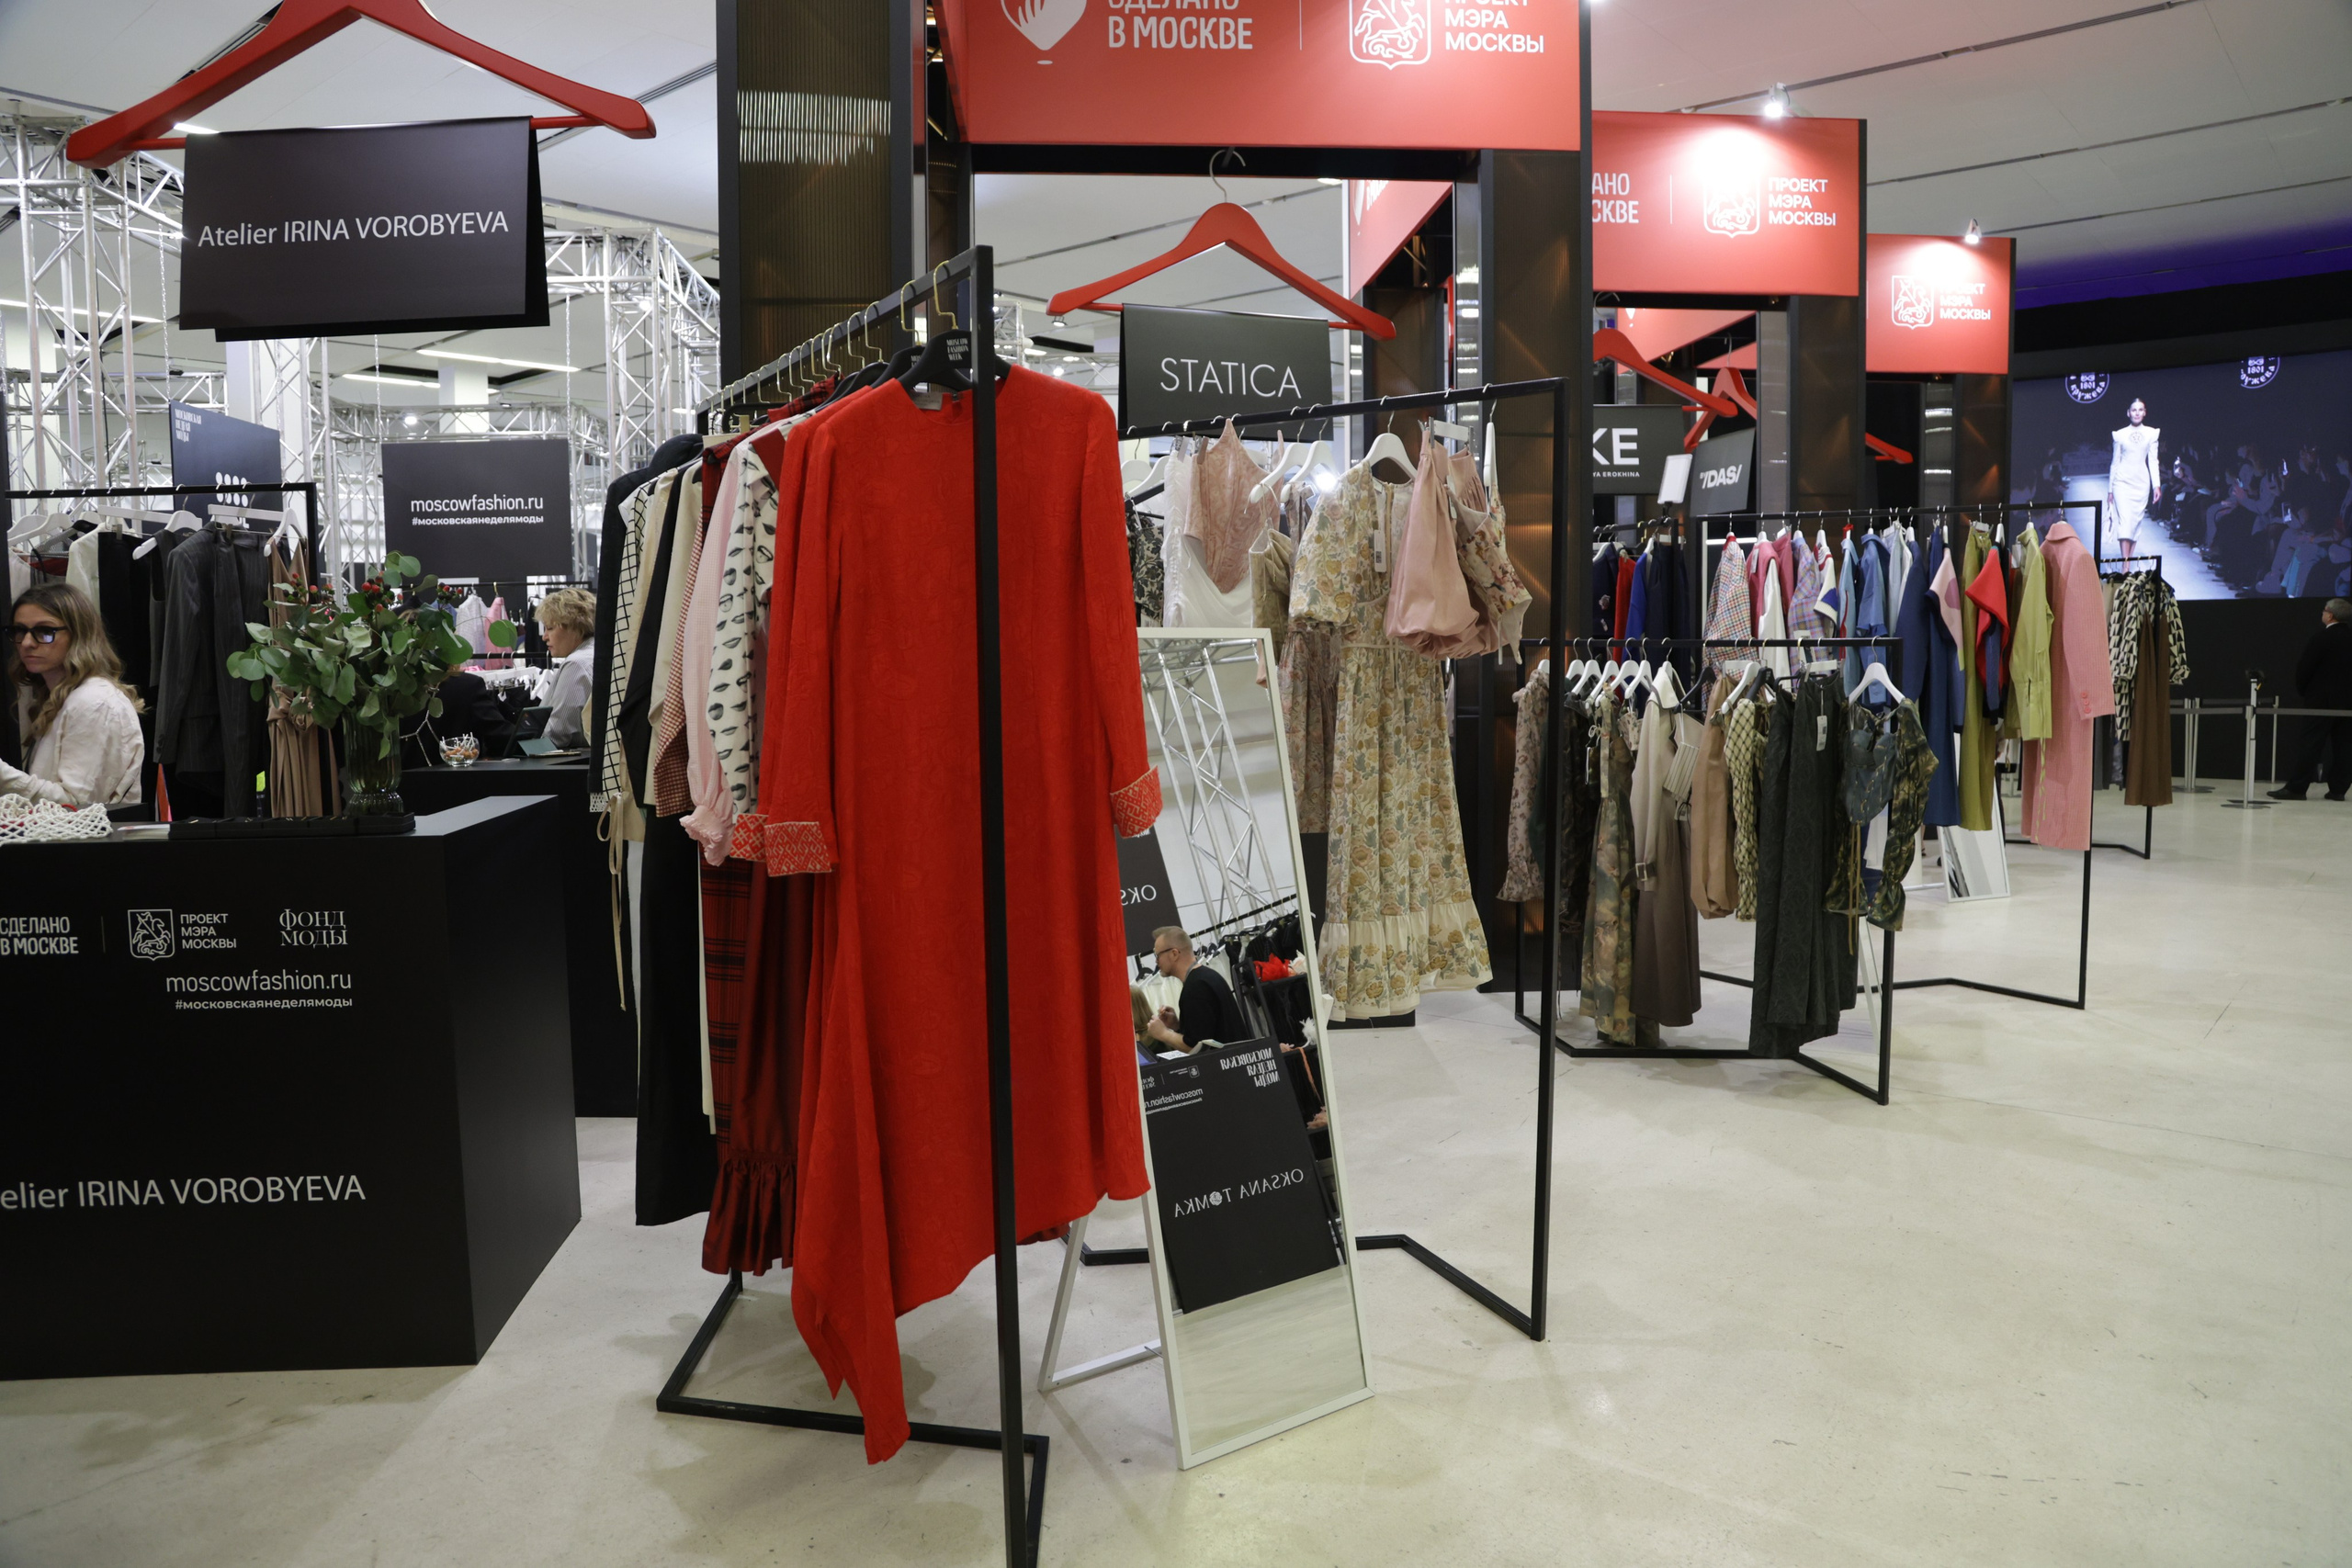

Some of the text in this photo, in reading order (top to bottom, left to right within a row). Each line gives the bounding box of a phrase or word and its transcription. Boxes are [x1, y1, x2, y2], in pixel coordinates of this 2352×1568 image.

[1445, 8, 1509, 28] МЭРА
[1108, 16, 1253, 50] В МОСКВЕ
[1445, 31, 1544, 53] МОСКВЫ
[1769, 177, 1828, 193] ПРОЕКТ
[1769, 194, 1813, 209] МЭРА
[1592, 199, 1640, 223] СКВЕ
[1769, 210, 1837, 227] МОСКВЫ
[198, 210, 509, 247] Atelier IRINA VOROBYEVA
[1939, 308, 1991, 320] МОСКВЫ
[1159, 357, 1302, 399] STATICA
[1592, 428, 1639, 465] KE
[411, 494, 544, 512] moscowfashion.ru
[412, 514, 544, 526] #московскаянеделямоды
[0, 917, 71, 937] СДЕЛАНО
[180, 913, 229, 924] ПРОЕКТ
[279, 908, 345, 931] ФОНД
[181, 926, 217, 937] МЭРА
[280, 930, 348, 948] МОДЫ
[0, 937, 79, 955] В МОСКВЕ
[181, 939, 237, 950] МОСКВЫ
[166, 969, 352, 992] moscowfashion.ru
[175, 997, 353, 1010] #московскаянеделямоды
[0, 1175, 367, 1209] elier IRINA VOROBYEVA
